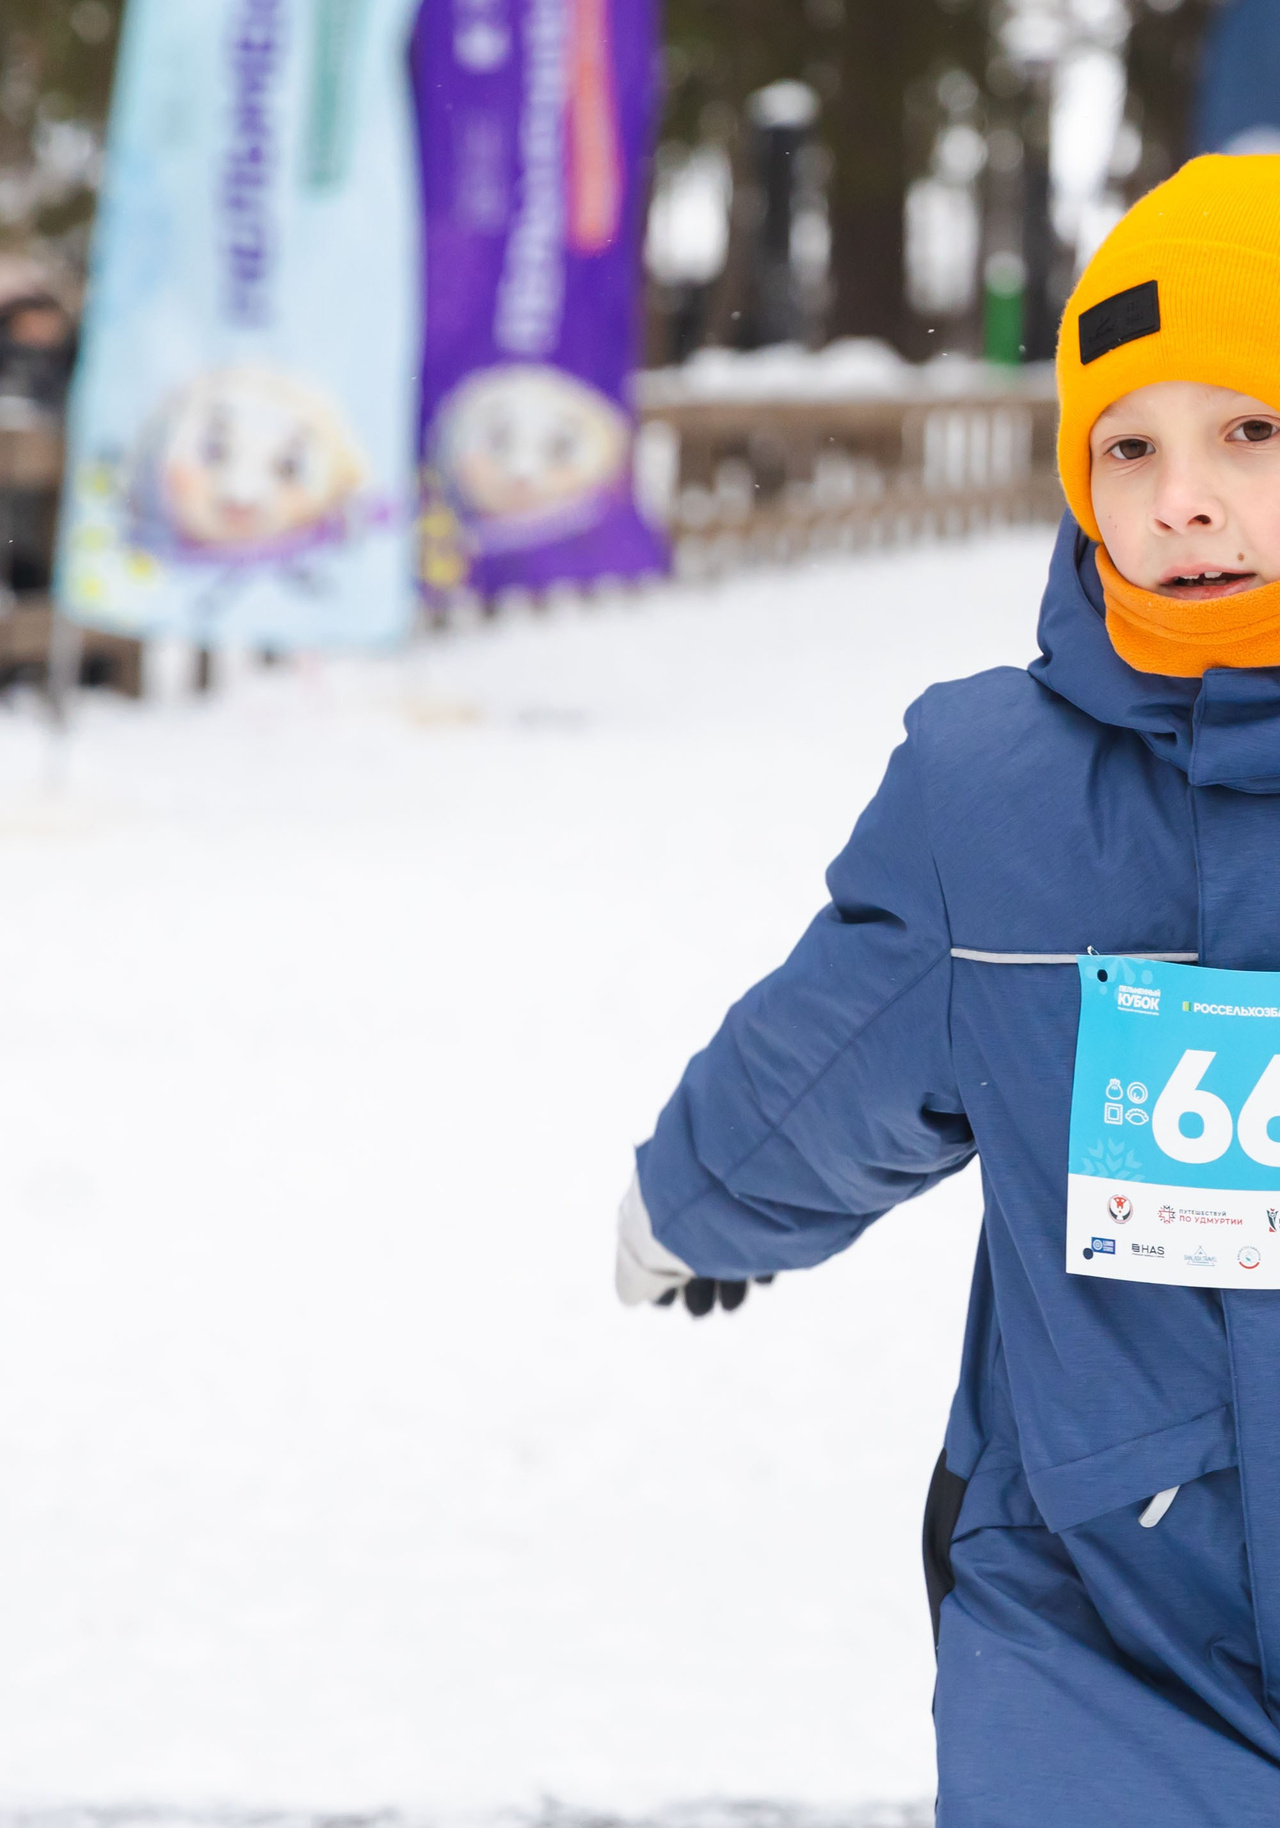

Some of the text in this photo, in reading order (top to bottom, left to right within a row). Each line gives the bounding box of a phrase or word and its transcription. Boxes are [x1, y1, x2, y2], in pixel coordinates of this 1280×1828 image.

[1117, 993, 1160, 1011] КУБОК
[1178, 1208, 1227, 1217] ПУТЕШЕСТВУЙ
[1179, 1215, 1243, 1226] ПО УДМУРТИИ
[1141, 1245, 1165, 1255] HAS
